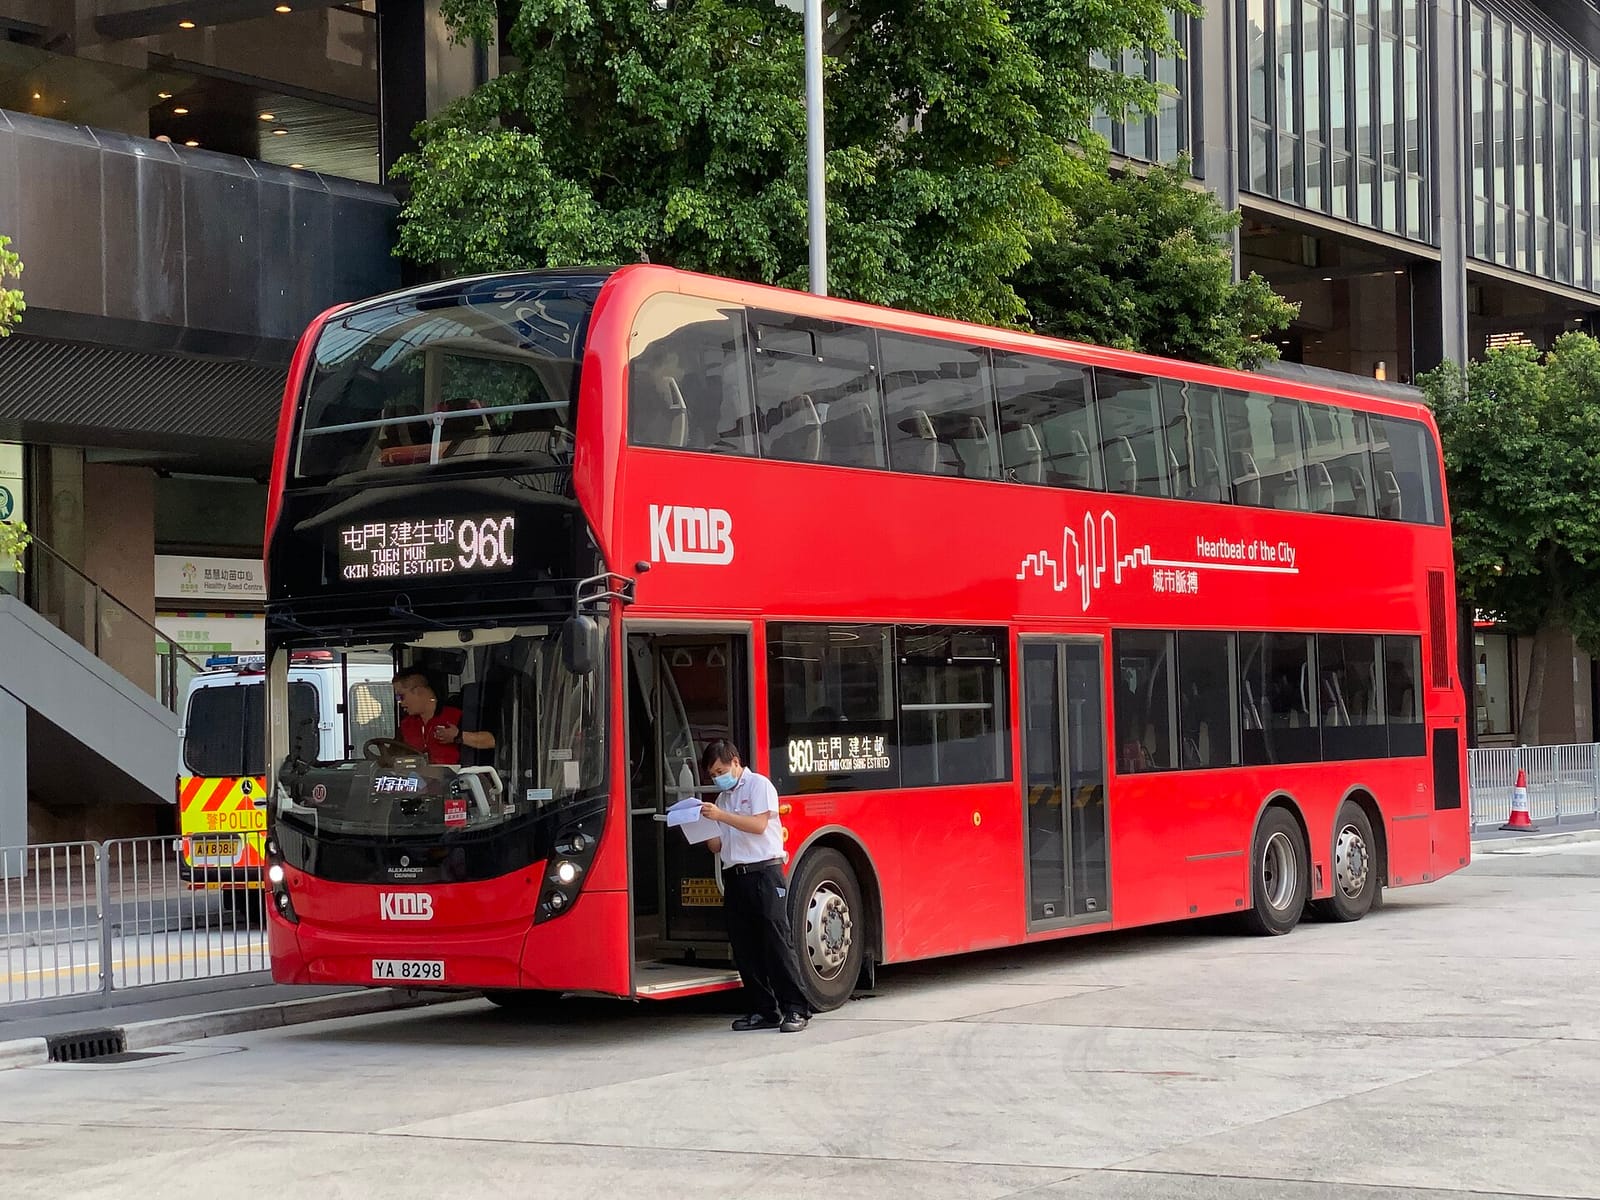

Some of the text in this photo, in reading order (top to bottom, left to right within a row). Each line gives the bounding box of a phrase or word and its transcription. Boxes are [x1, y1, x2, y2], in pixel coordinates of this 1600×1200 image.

[458, 516, 515, 569] 960
[649, 504, 734, 565] KMB
[371, 546, 426, 563] TUEN MUN
[1196, 535, 1296, 568] Heartbeat of the City
[372, 562, 400, 576] SANG
[403, 558, 455, 575] ESTATE)
[204, 581, 226, 591] Healthy
[243, 583, 263, 591] Centre
[1152, 568, 1199, 594] 城市脈搏
[789, 739, 813, 773] 960
[817, 736, 842, 759] 屯門
[814, 759, 828, 772] TUEN
[828, 759, 840, 771] MUN
[853, 758, 866, 770] SANG
[380, 892, 434, 920] KMB
[375, 961, 442, 979] YA 8298
